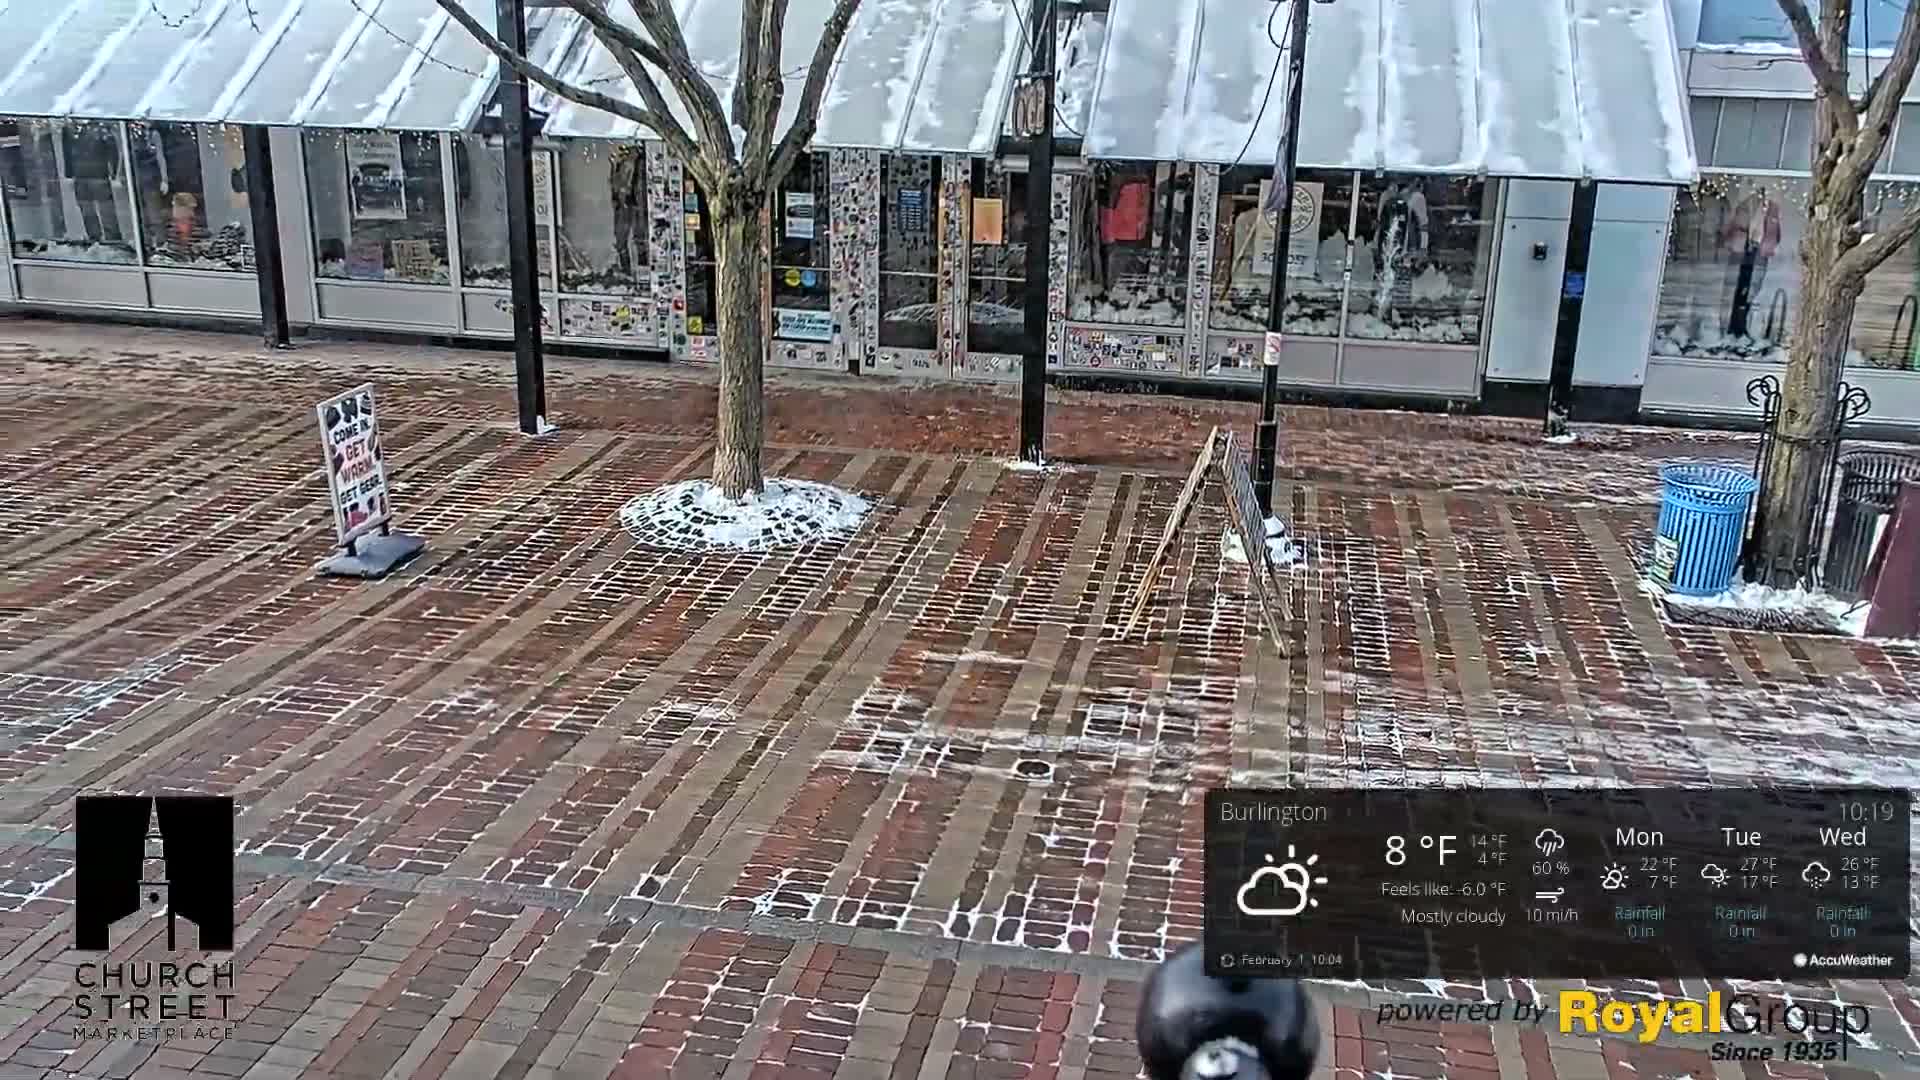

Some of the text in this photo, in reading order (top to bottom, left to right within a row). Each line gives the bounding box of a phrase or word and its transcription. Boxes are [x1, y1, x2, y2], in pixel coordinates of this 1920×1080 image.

[334, 422, 359, 445] COME
[345, 438, 365, 461] GET
[340, 485, 358, 505] GET
